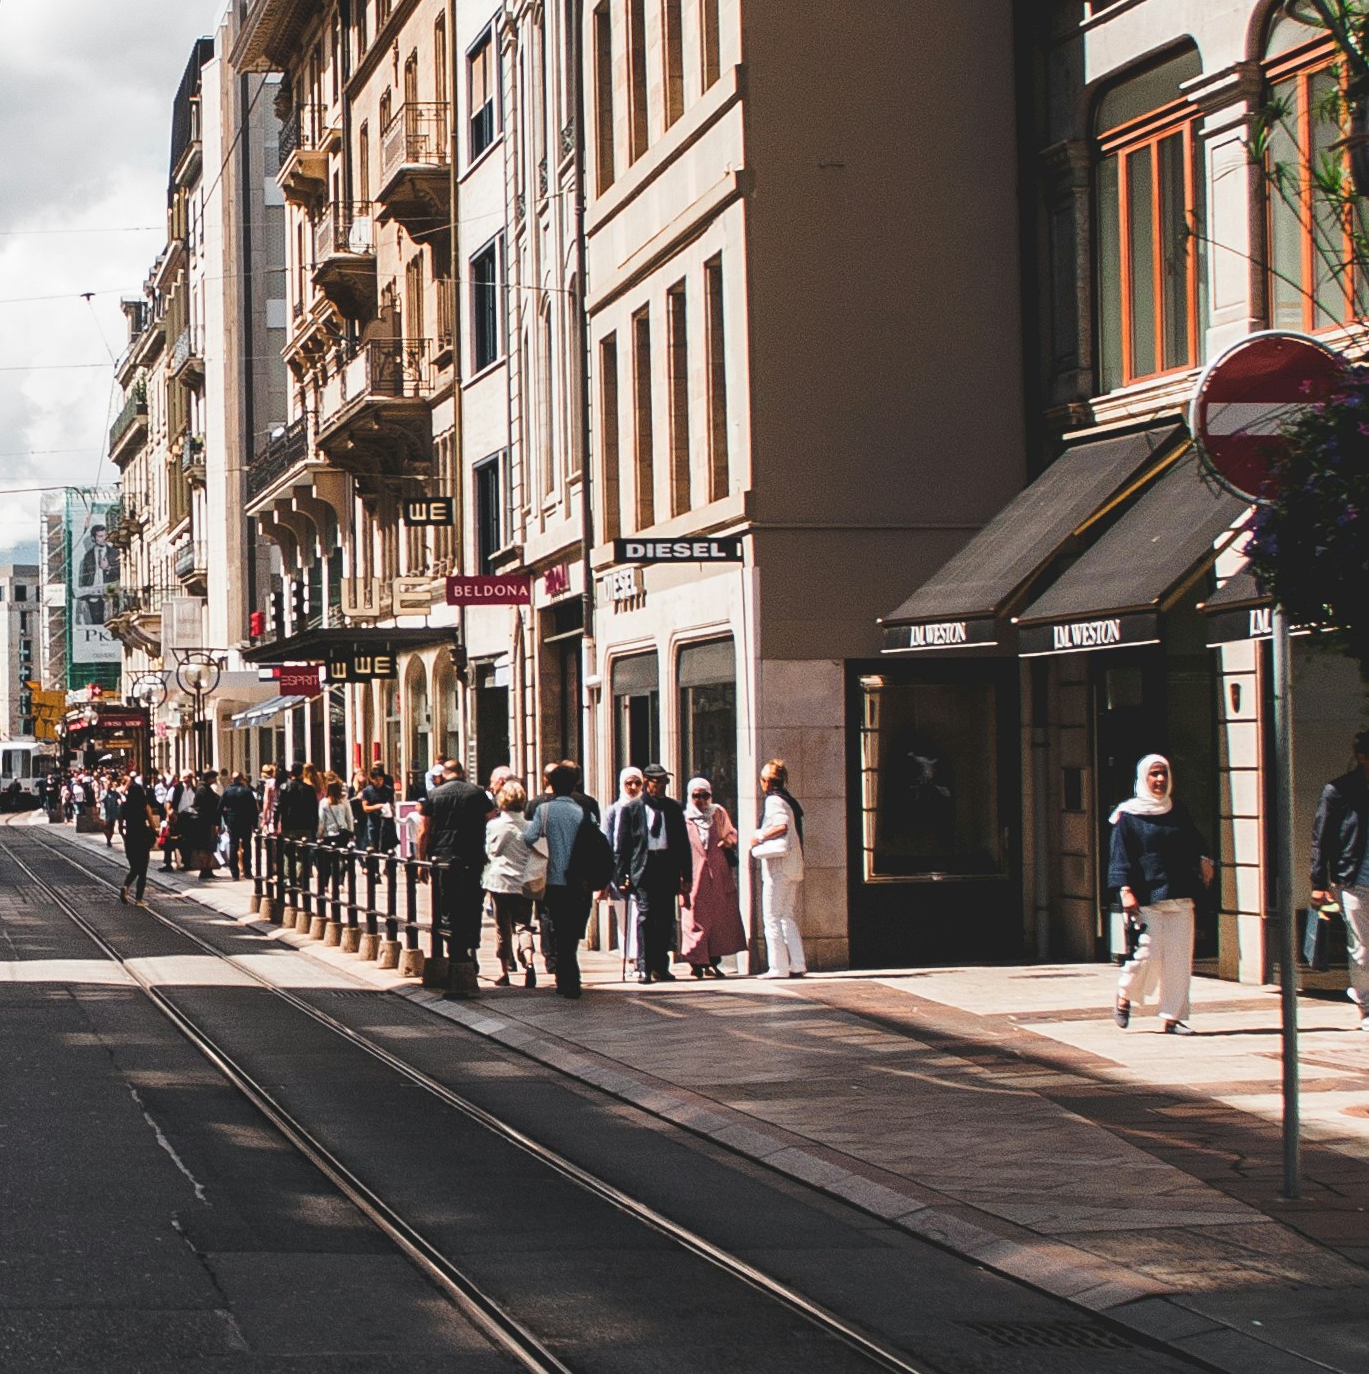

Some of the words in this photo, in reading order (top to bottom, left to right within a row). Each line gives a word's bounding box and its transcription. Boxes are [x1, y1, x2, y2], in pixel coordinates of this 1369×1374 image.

[409, 502, 447, 521] WE
[626, 543, 726, 558] DIESEL
[341, 577, 431, 616] WE
[454, 584, 528, 597] BELDONA
[925, 622, 966, 645] WESTON
[1071, 619, 1120, 646] WESTON
[354, 656, 391, 673] WE
[281, 674, 319, 686] ESPRIT
